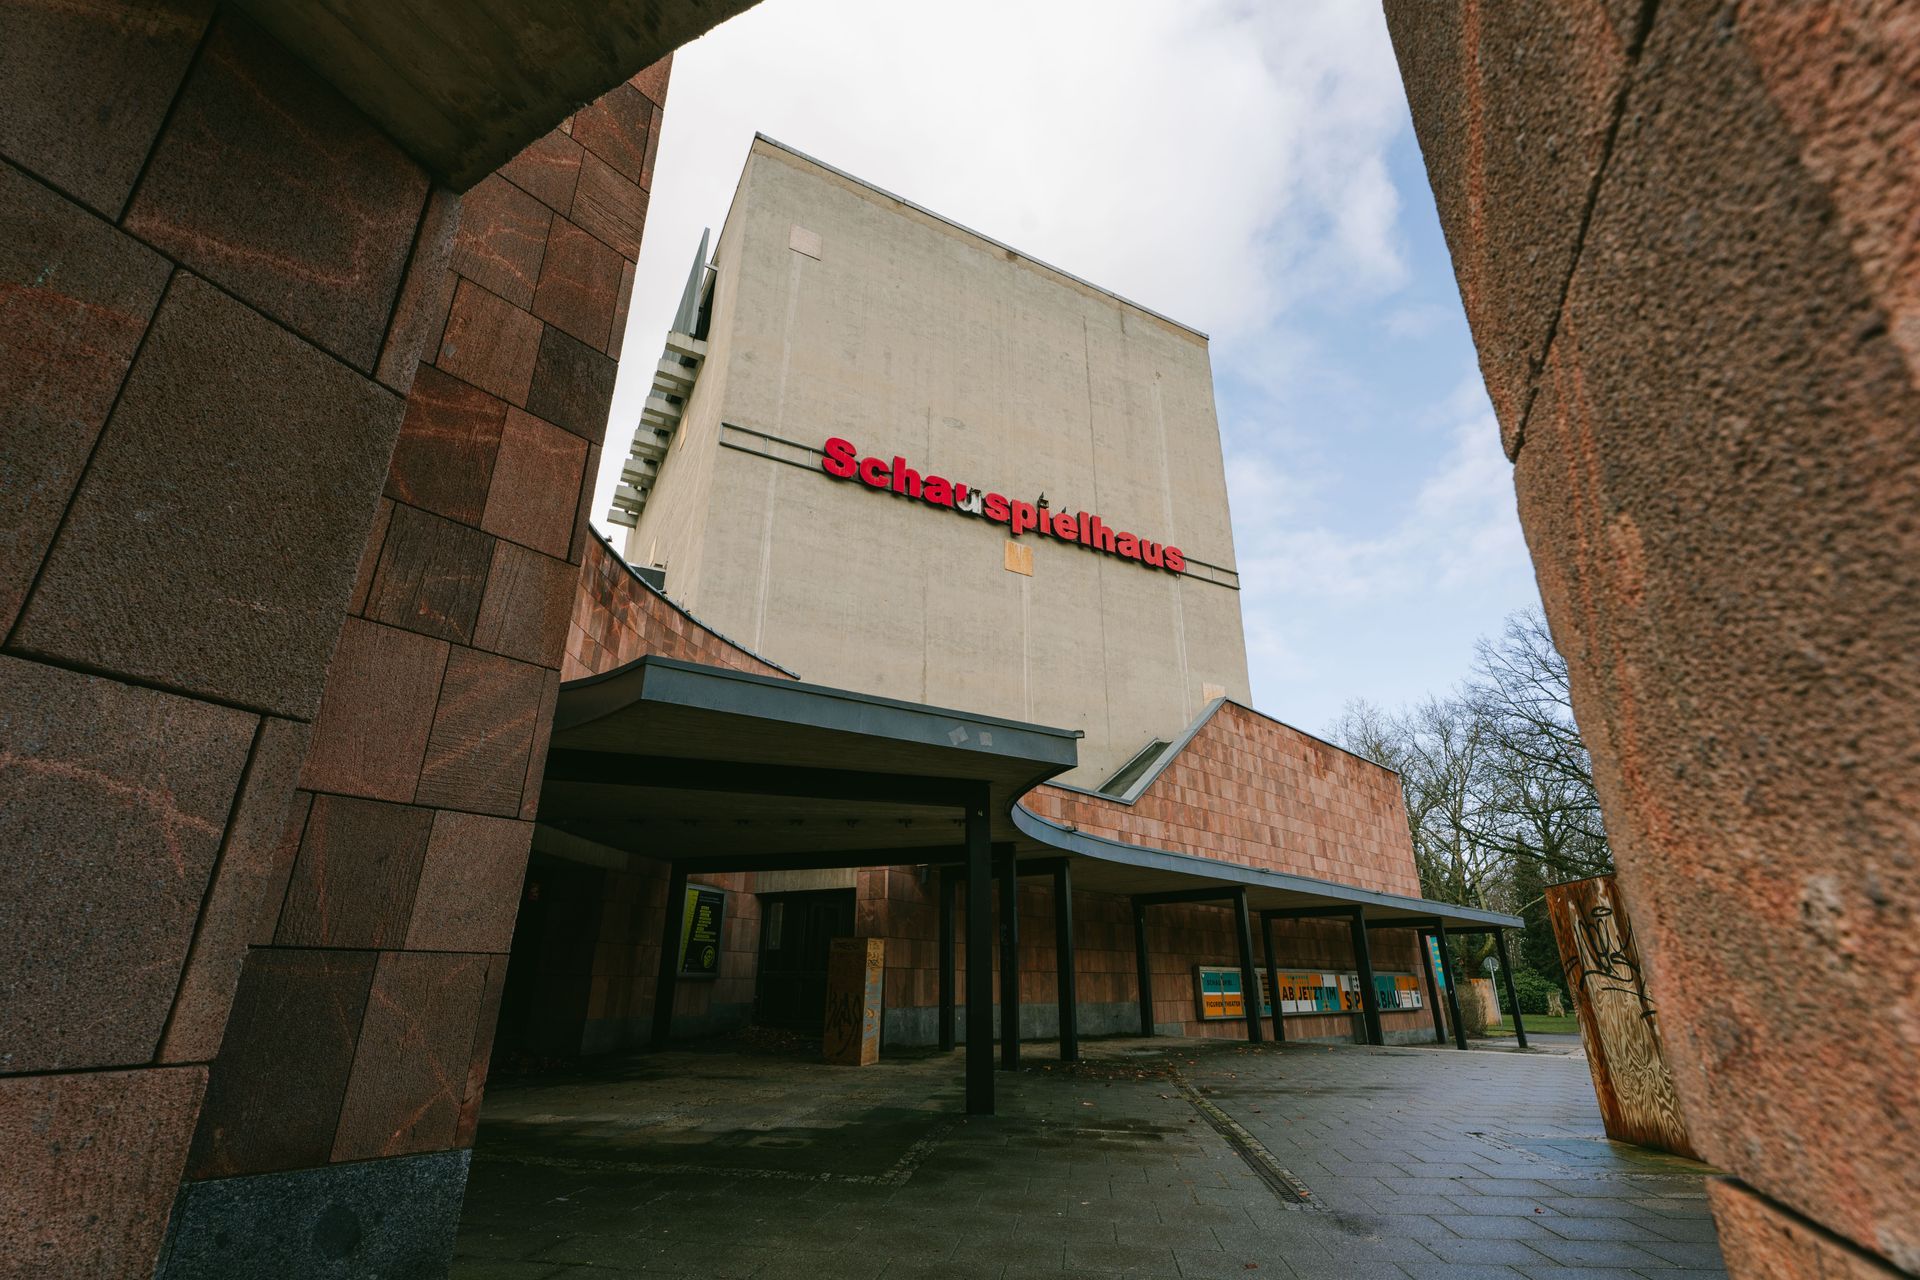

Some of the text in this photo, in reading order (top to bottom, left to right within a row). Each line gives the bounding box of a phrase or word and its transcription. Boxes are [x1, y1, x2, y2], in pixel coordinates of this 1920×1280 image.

[822, 437, 1185, 572] Schauspielhaus
[1282, 986, 1295, 1001] AB
[1298, 986, 1323, 1001] JETZT
[1325, 986, 1337, 1001] IM
[1344, 990, 1400, 1010] SPBAU
